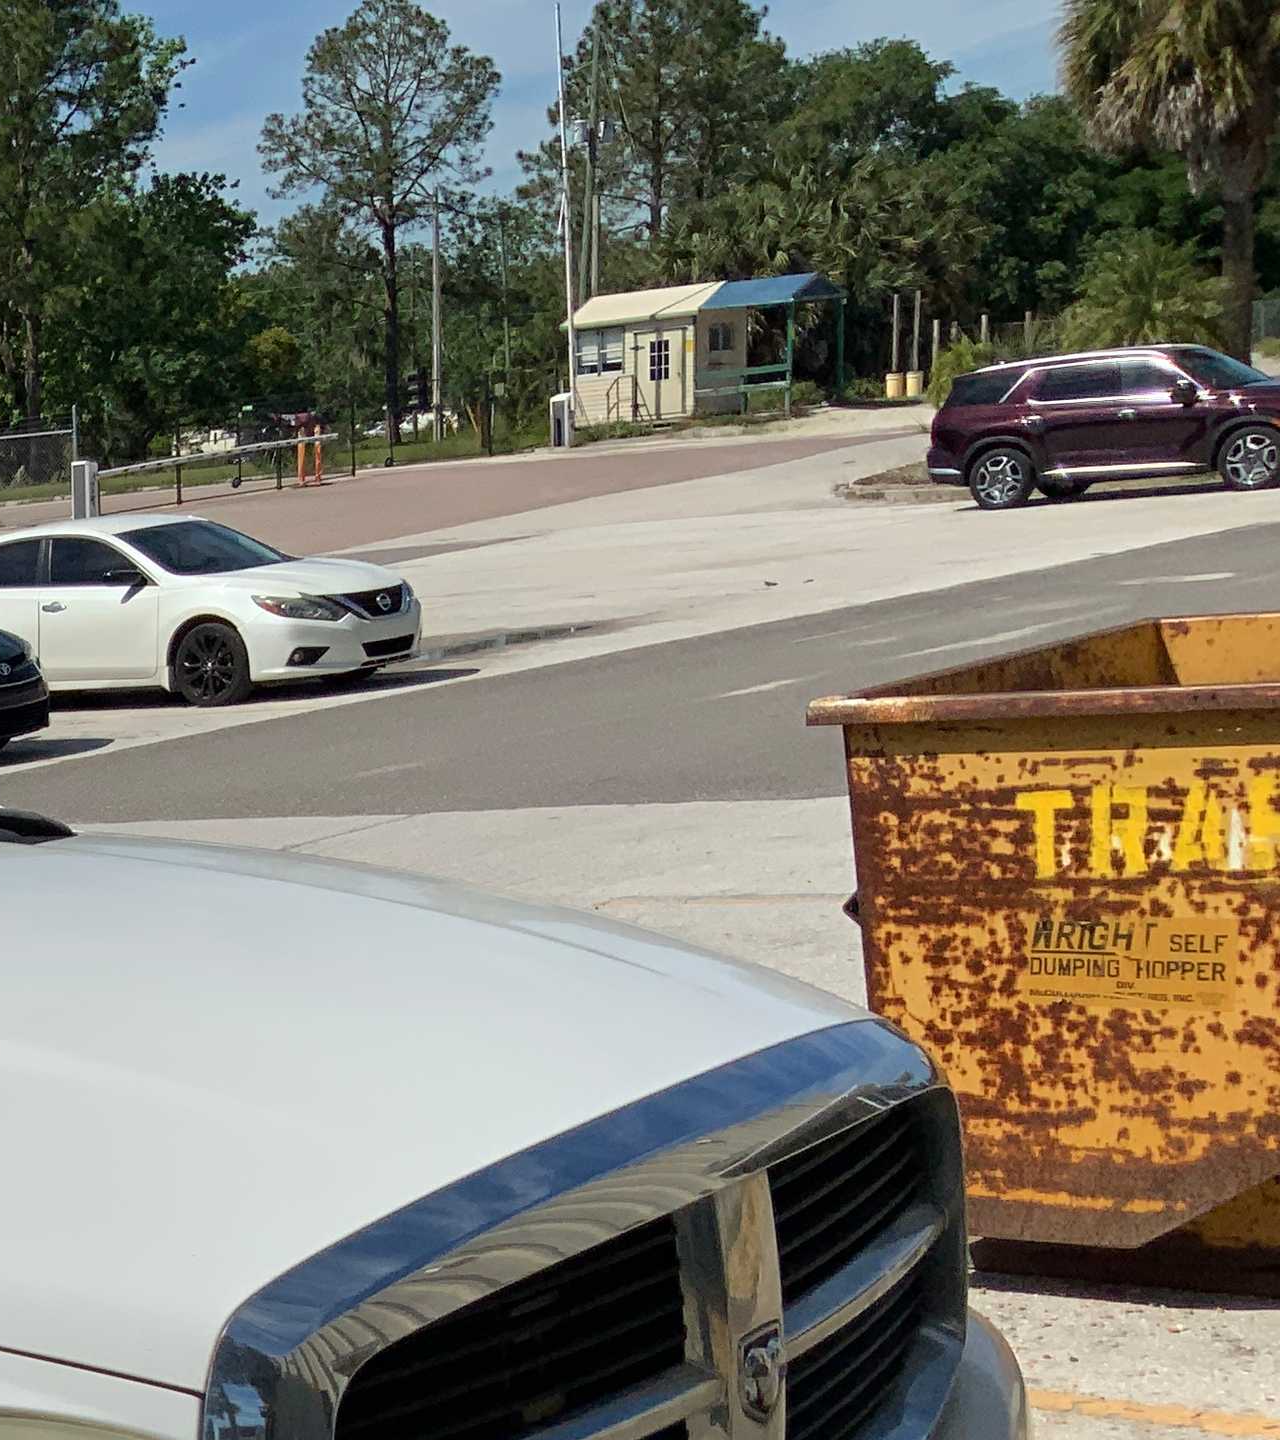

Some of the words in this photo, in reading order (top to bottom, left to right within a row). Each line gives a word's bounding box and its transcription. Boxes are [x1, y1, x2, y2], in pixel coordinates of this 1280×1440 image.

[1031, 920, 1158, 950] WRIGHT
[1169, 934, 1228, 954] SELF
[1029, 956, 1120, 978] DUMPING
[1136, 958, 1226, 982] HOPPER
